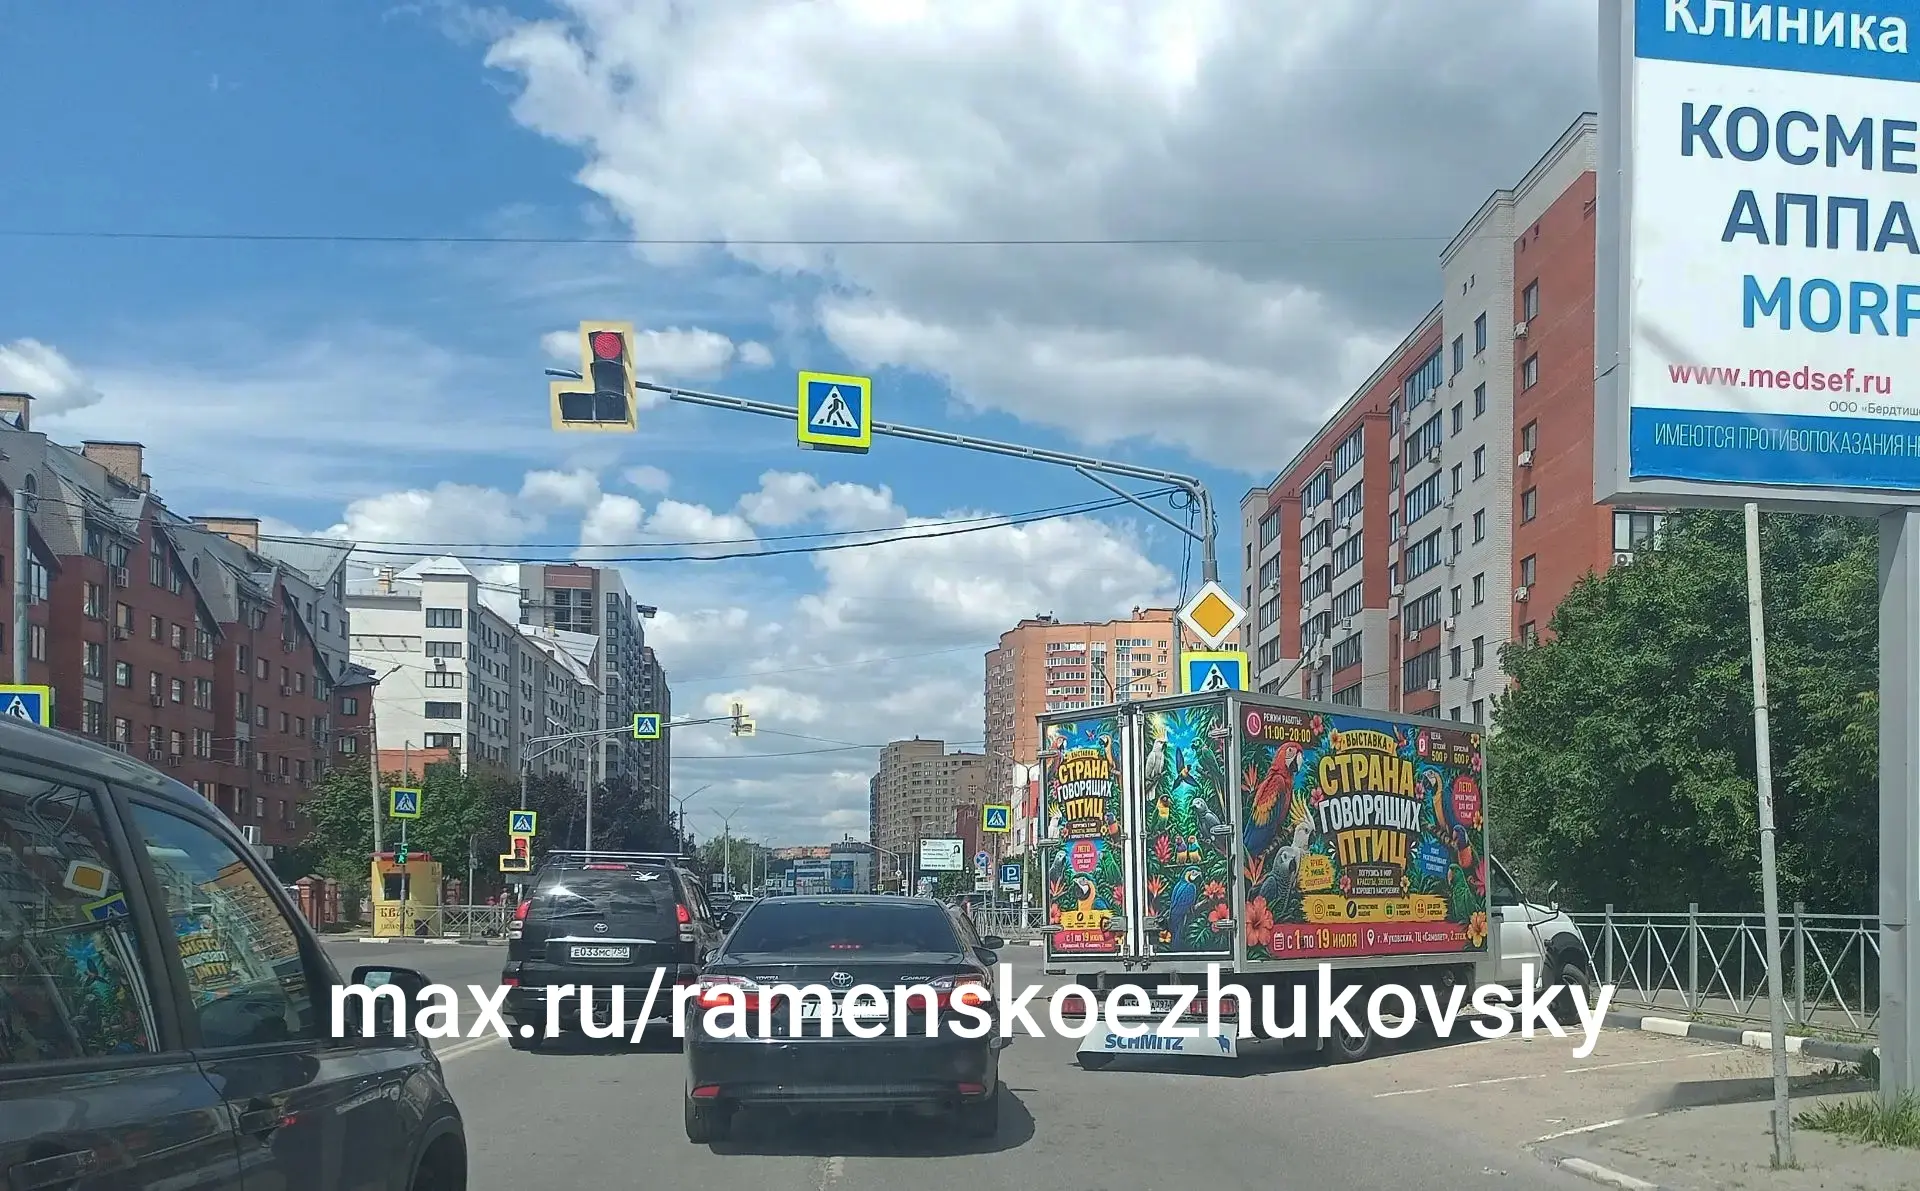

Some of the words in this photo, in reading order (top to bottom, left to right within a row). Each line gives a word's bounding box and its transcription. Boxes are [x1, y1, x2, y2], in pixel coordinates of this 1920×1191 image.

[1664, 0, 1909, 54] Клиника
[1681, 102, 1918, 174] КОСМЕ
[1721, 189, 1920, 255] АППА
[1668, 363, 1892, 395] www.medsef.ru
[1829, 401, 1858, 413] ООО
[1861, 402, 1920, 417] «Бердтиш
[1655, 422, 1734, 448] ИМЕЮТСЯ
[1738, 426, 1903, 458] ПРОТИВОПОКАЗАНИЯ
[1345, 731, 1388, 750] ВЫСТАВКА
[1431, 750, 1443, 762] 500
[1453, 753, 1465, 764] 600
[1058, 759, 1109, 784] СТРАНА
[1318, 754, 1415, 798] СТРАНА
[1057, 779, 1112, 803] ГОВОРЯЩИХ
[1066, 798, 1104, 821] ПТИЦ
[1318, 794, 1422, 833] ГОВОРЯЩИХ
[1336, 828, 1407, 869] ПТИЦ
[1294, 929, 1301, 950] 1
[1316, 928, 1330, 949] 19
[1104, 1033, 1185, 1051] SCHMITZ
